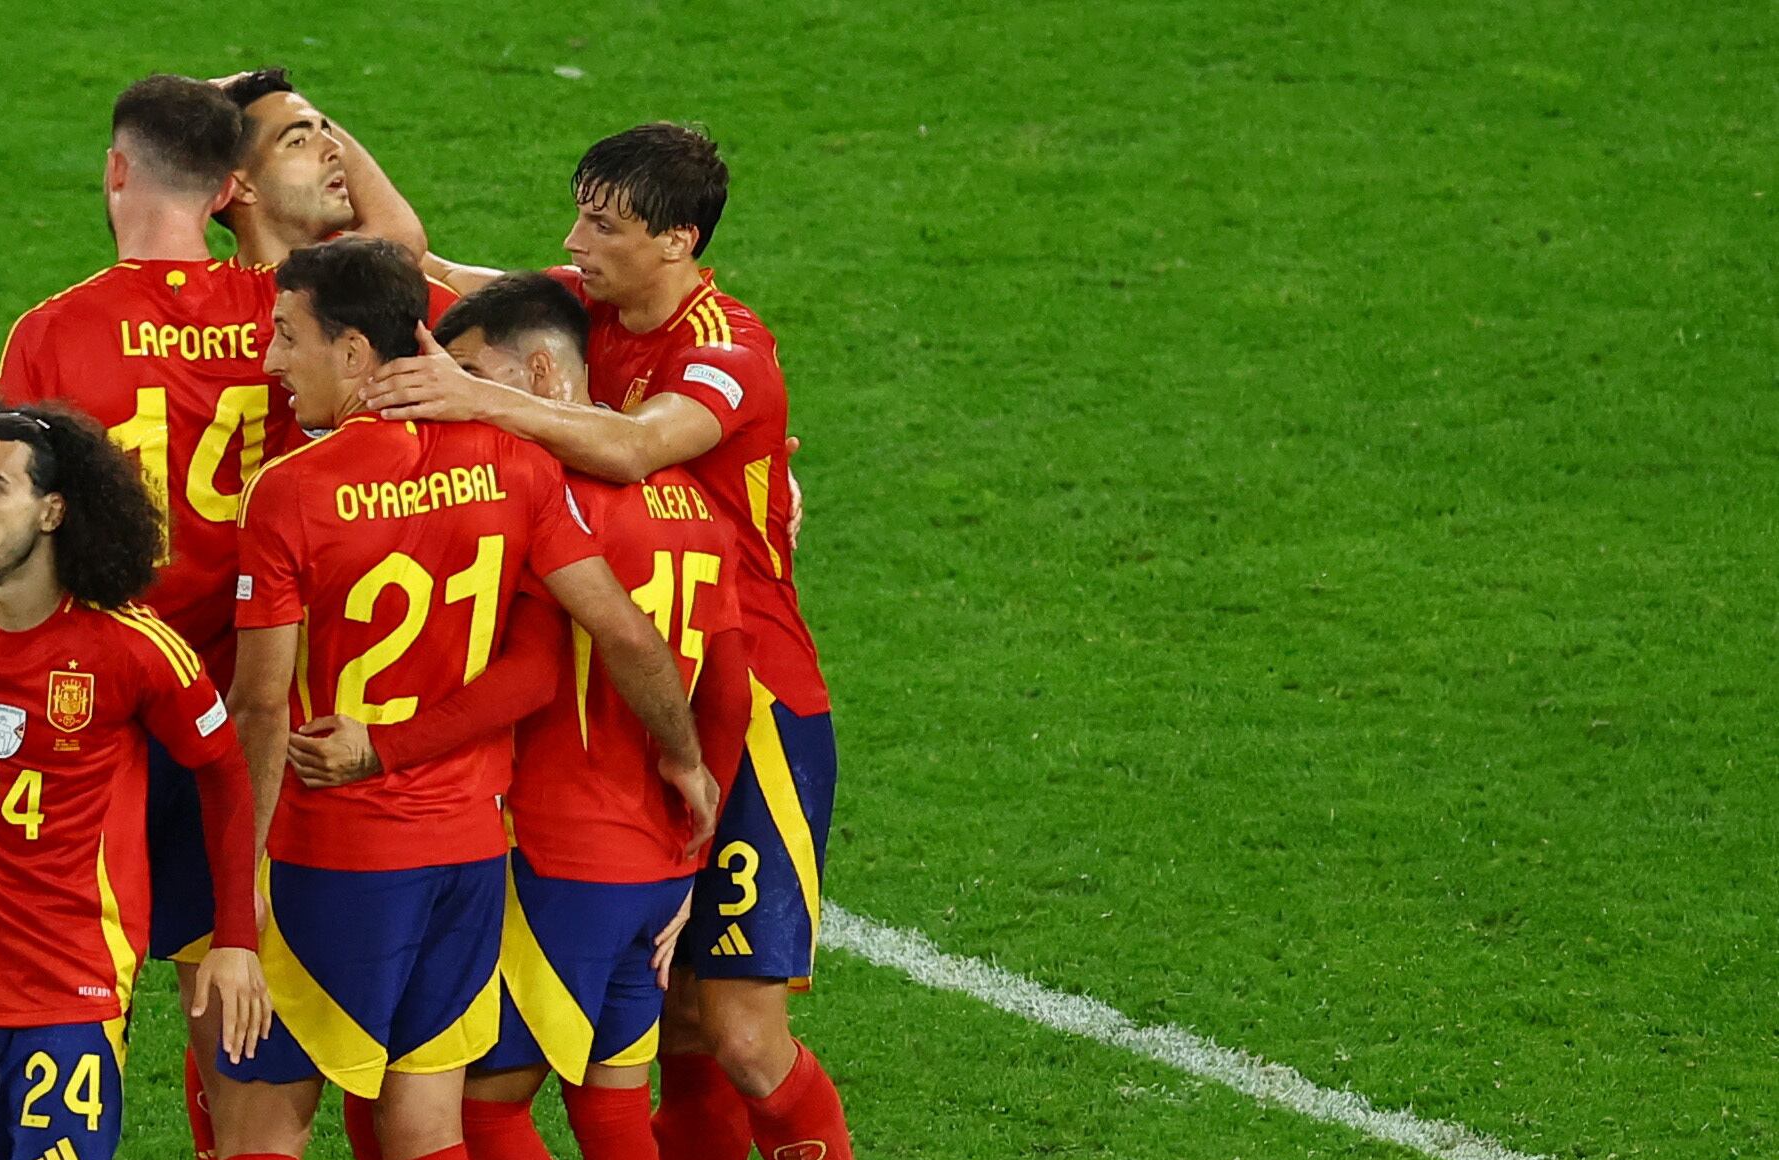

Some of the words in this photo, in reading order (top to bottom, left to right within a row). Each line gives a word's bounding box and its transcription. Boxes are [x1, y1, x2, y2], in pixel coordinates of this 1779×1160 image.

[121, 320, 259, 361] LAPORTE
[107, 385, 269, 568] 14
[336, 464, 507, 521] OYARZABAL
[688, 486, 714, 522] B.
[334, 534, 504, 725] 21
[630, 551, 721, 703] 15
[718, 841, 759, 915] 3
[20, 1051, 104, 1131] 24
